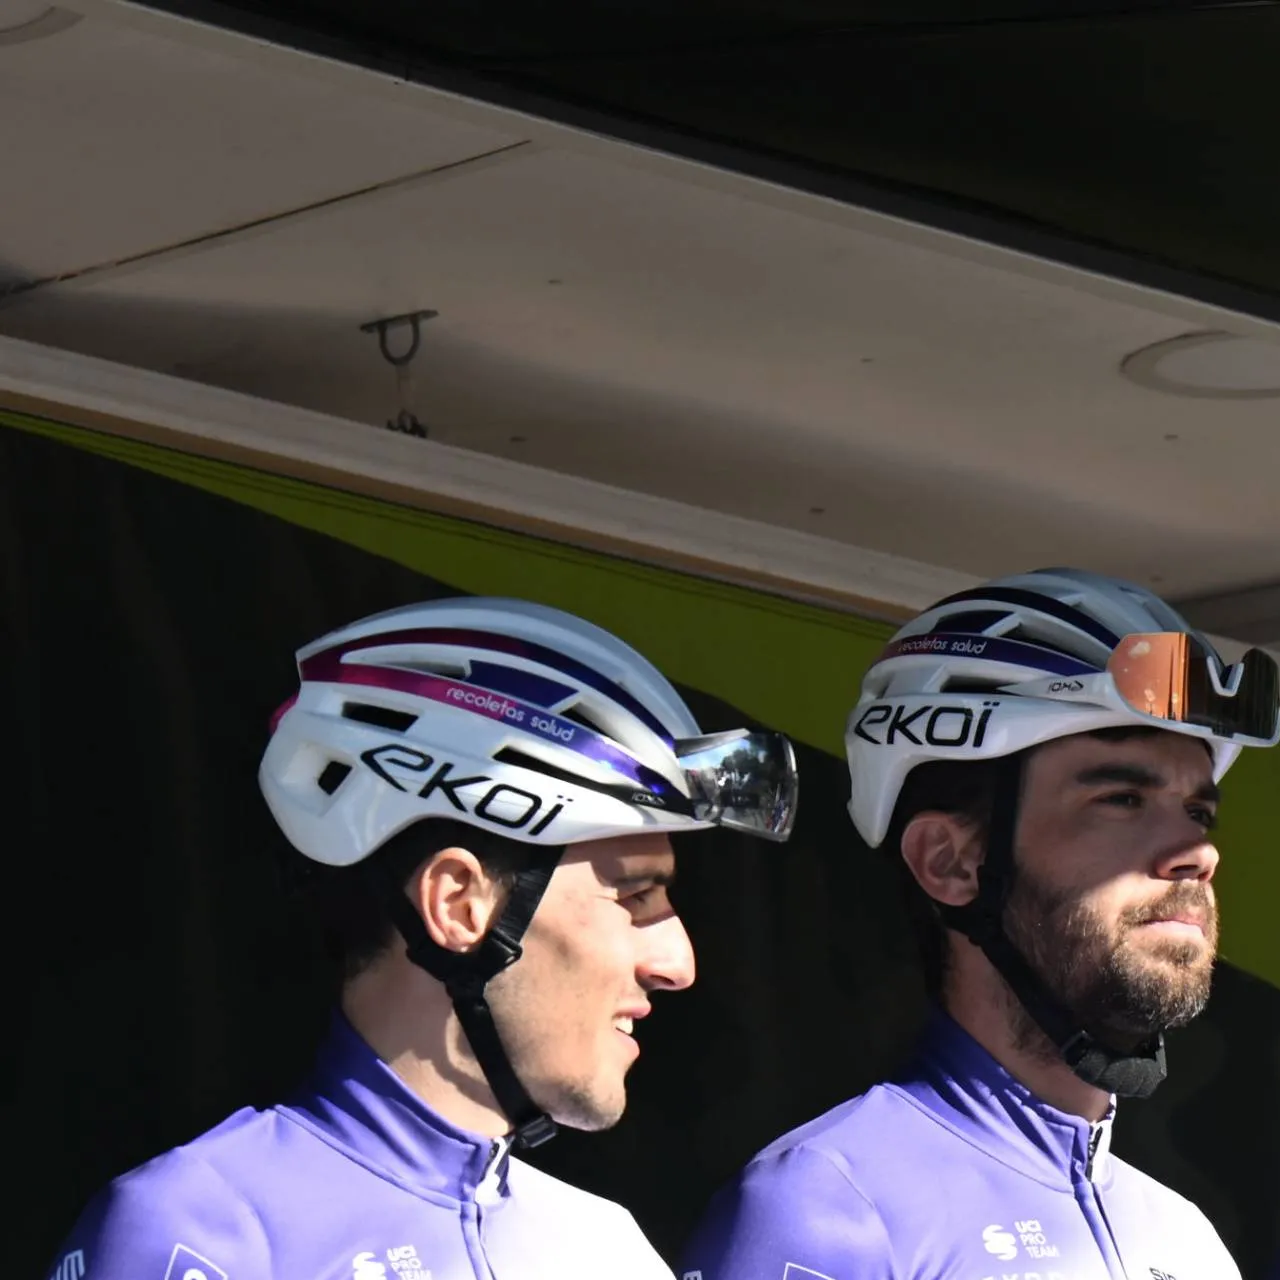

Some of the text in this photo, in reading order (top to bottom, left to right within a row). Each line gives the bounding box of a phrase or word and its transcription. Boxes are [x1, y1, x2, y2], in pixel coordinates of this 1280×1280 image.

[951, 637, 987, 655] salud
[445, 685, 577, 744] recoletas salud
[1013, 1219, 1042, 1235] UCI
[1018, 1232, 1048, 1247] PRO
[1024, 1244, 1061, 1260] TEAM
